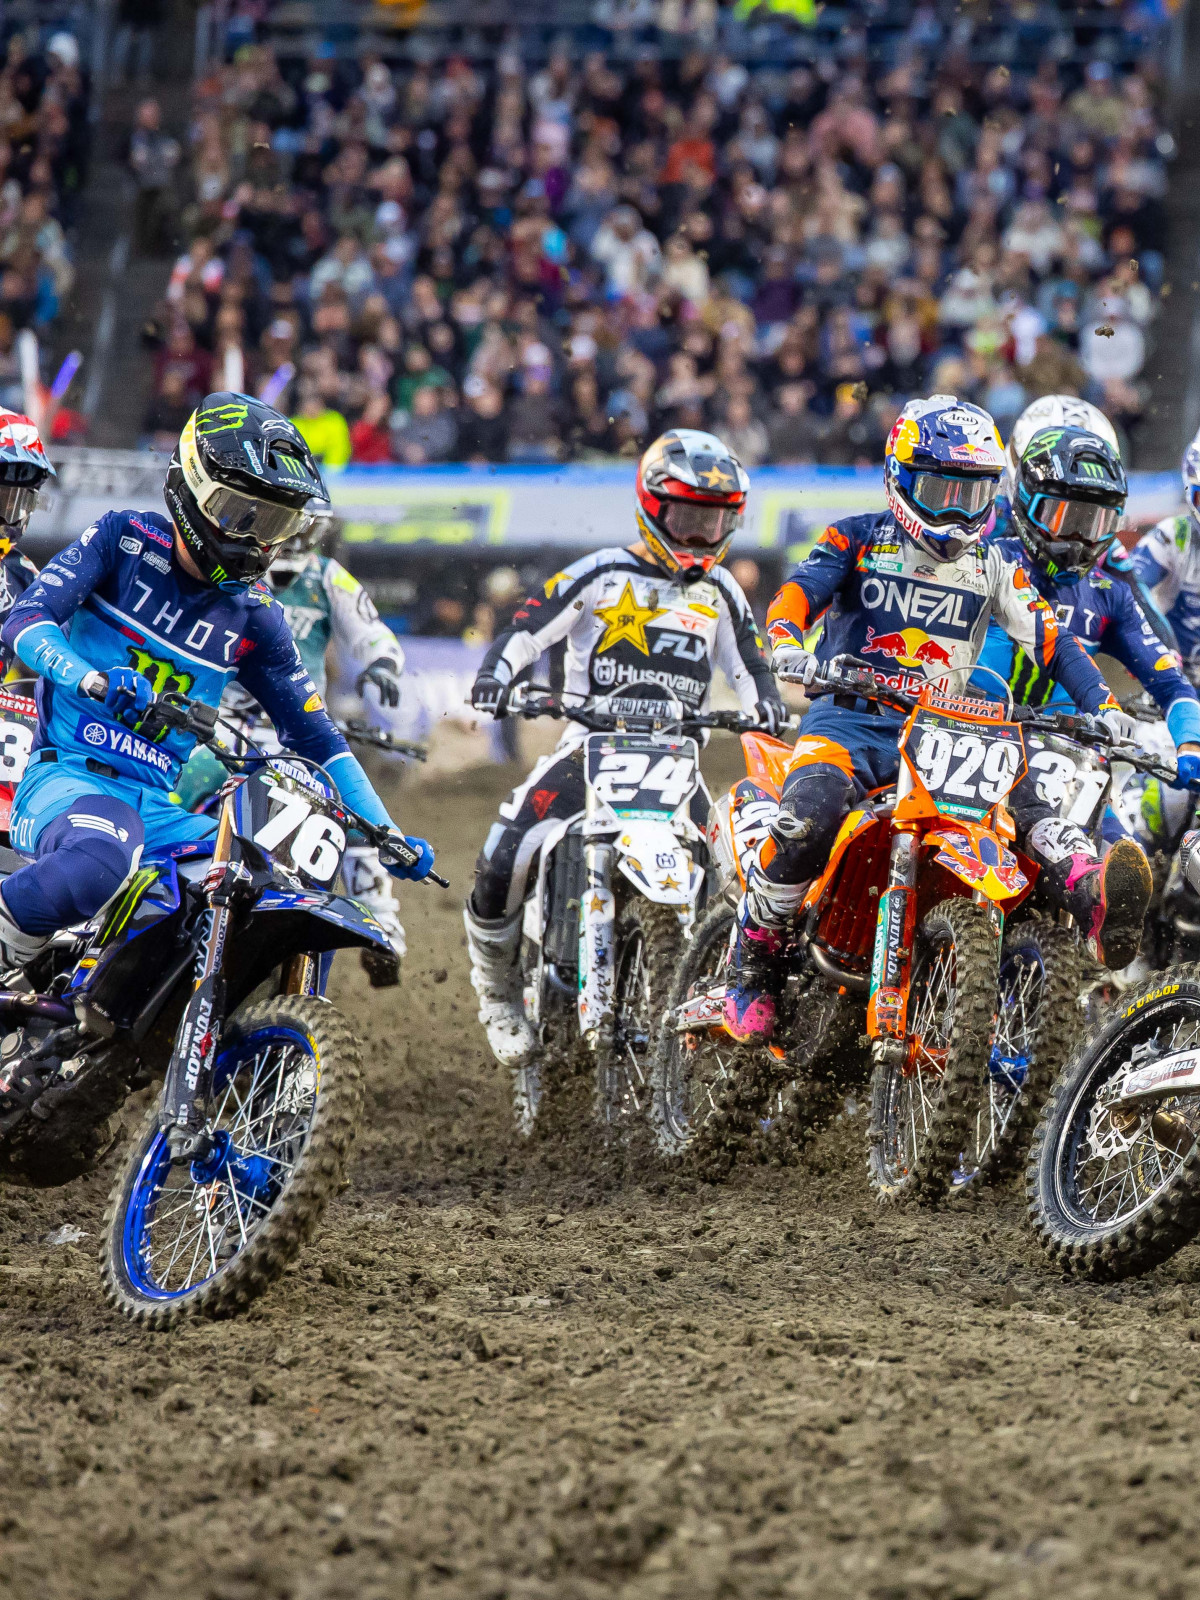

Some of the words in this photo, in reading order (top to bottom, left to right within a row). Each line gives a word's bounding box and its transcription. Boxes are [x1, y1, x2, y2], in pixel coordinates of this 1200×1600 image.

[947, 412, 974, 425] Arai
[895, 504, 922, 540] Bull
[931, 700, 1000, 720] RENTHAL
[955, 721, 989, 733] MONSTER
[593, 753, 695, 807] 24
[913, 730, 1020, 800] 929
[253, 785, 347, 882] 76
[949, 804, 985, 818] MOTOREX
[870, 923, 885, 990] MOTOREX
[186, 997, 213, 1092] DUNLOP
